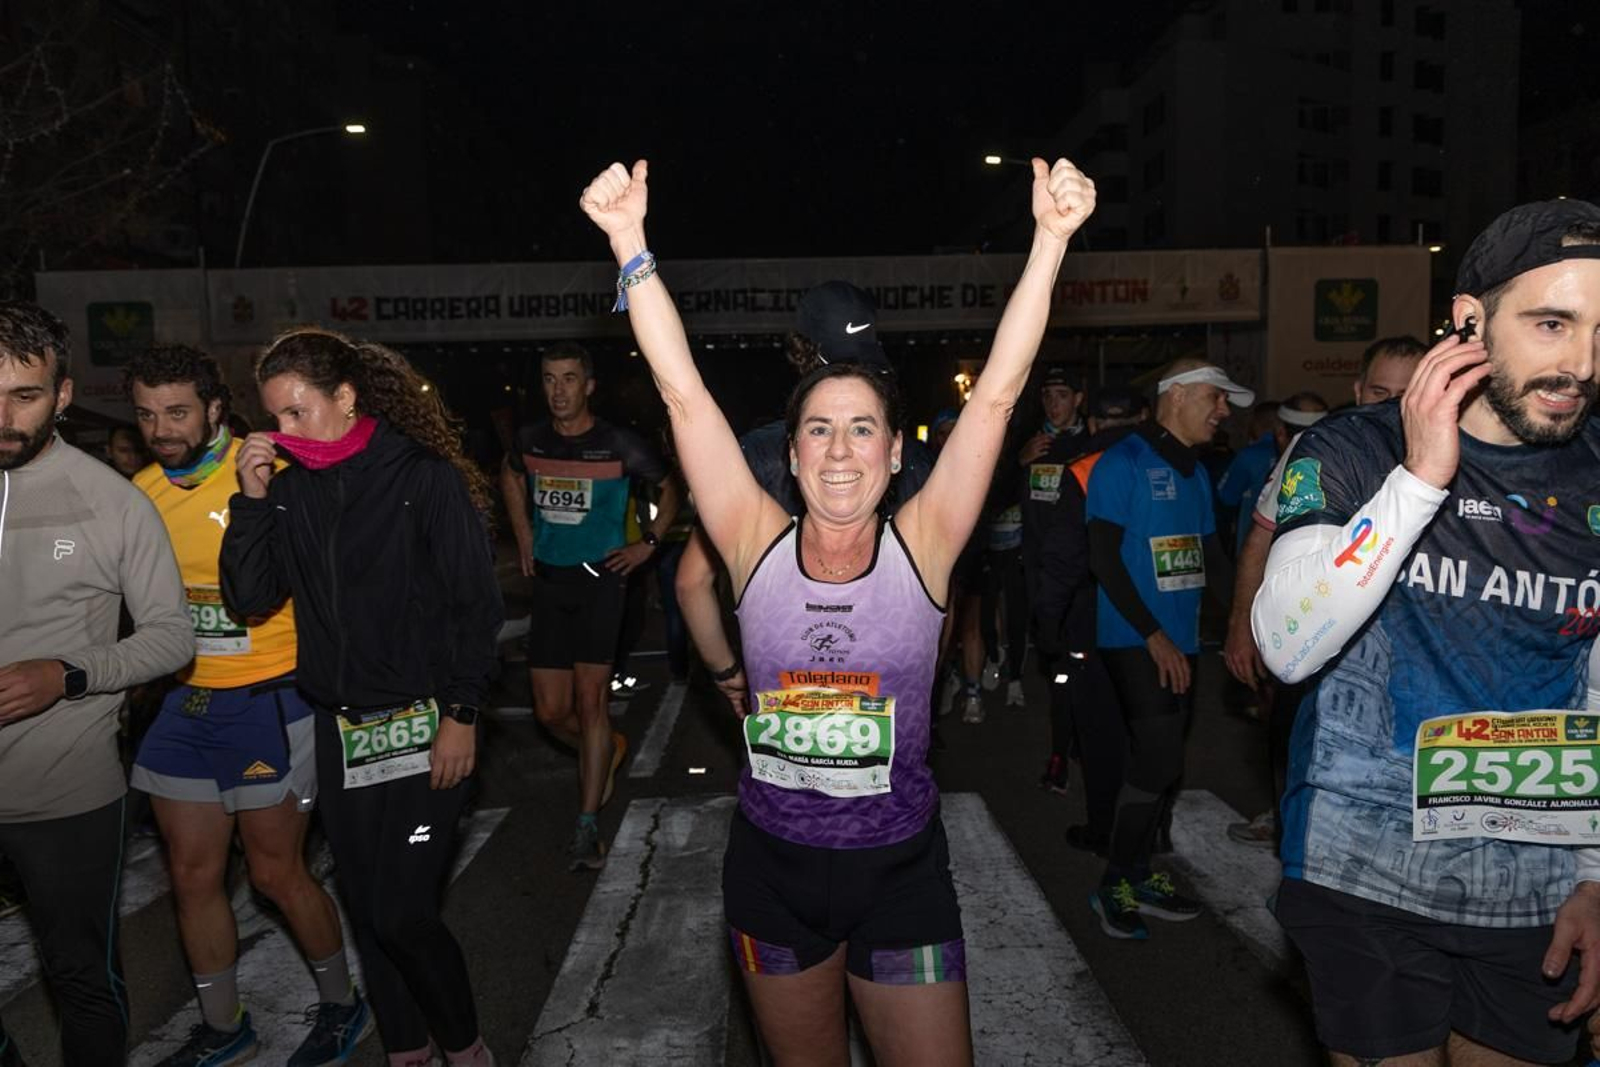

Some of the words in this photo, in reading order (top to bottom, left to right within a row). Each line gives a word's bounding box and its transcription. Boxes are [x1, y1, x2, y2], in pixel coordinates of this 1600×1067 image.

[331, 298, 369, 320] 42
[375, 296, 500, 320] CARRERA
[960, 284, 995, 307] DE
[539, 491, 585, 507] 7694
[1160, 548, 1201, 571] 1443
[1397, 552, 1467, 598] AN
[1480, 565, 1600, 618] ANTÓ
[789, 671, 871, 685] Toledano
[351, 715, 431, 759] 2665
[755, 712, 880, 756] 2869
[1457, 718, 1490, 741] 42
[1491, 729, 1514, 740] SAN
[1430, 749, 1599, 795] 2525
[1428, 795, 1471, 805] FRANCISCO
[1473, 795, 1502, 804] JAVIER
[1504, 797, 1547, 808] GONZÁLEZ
